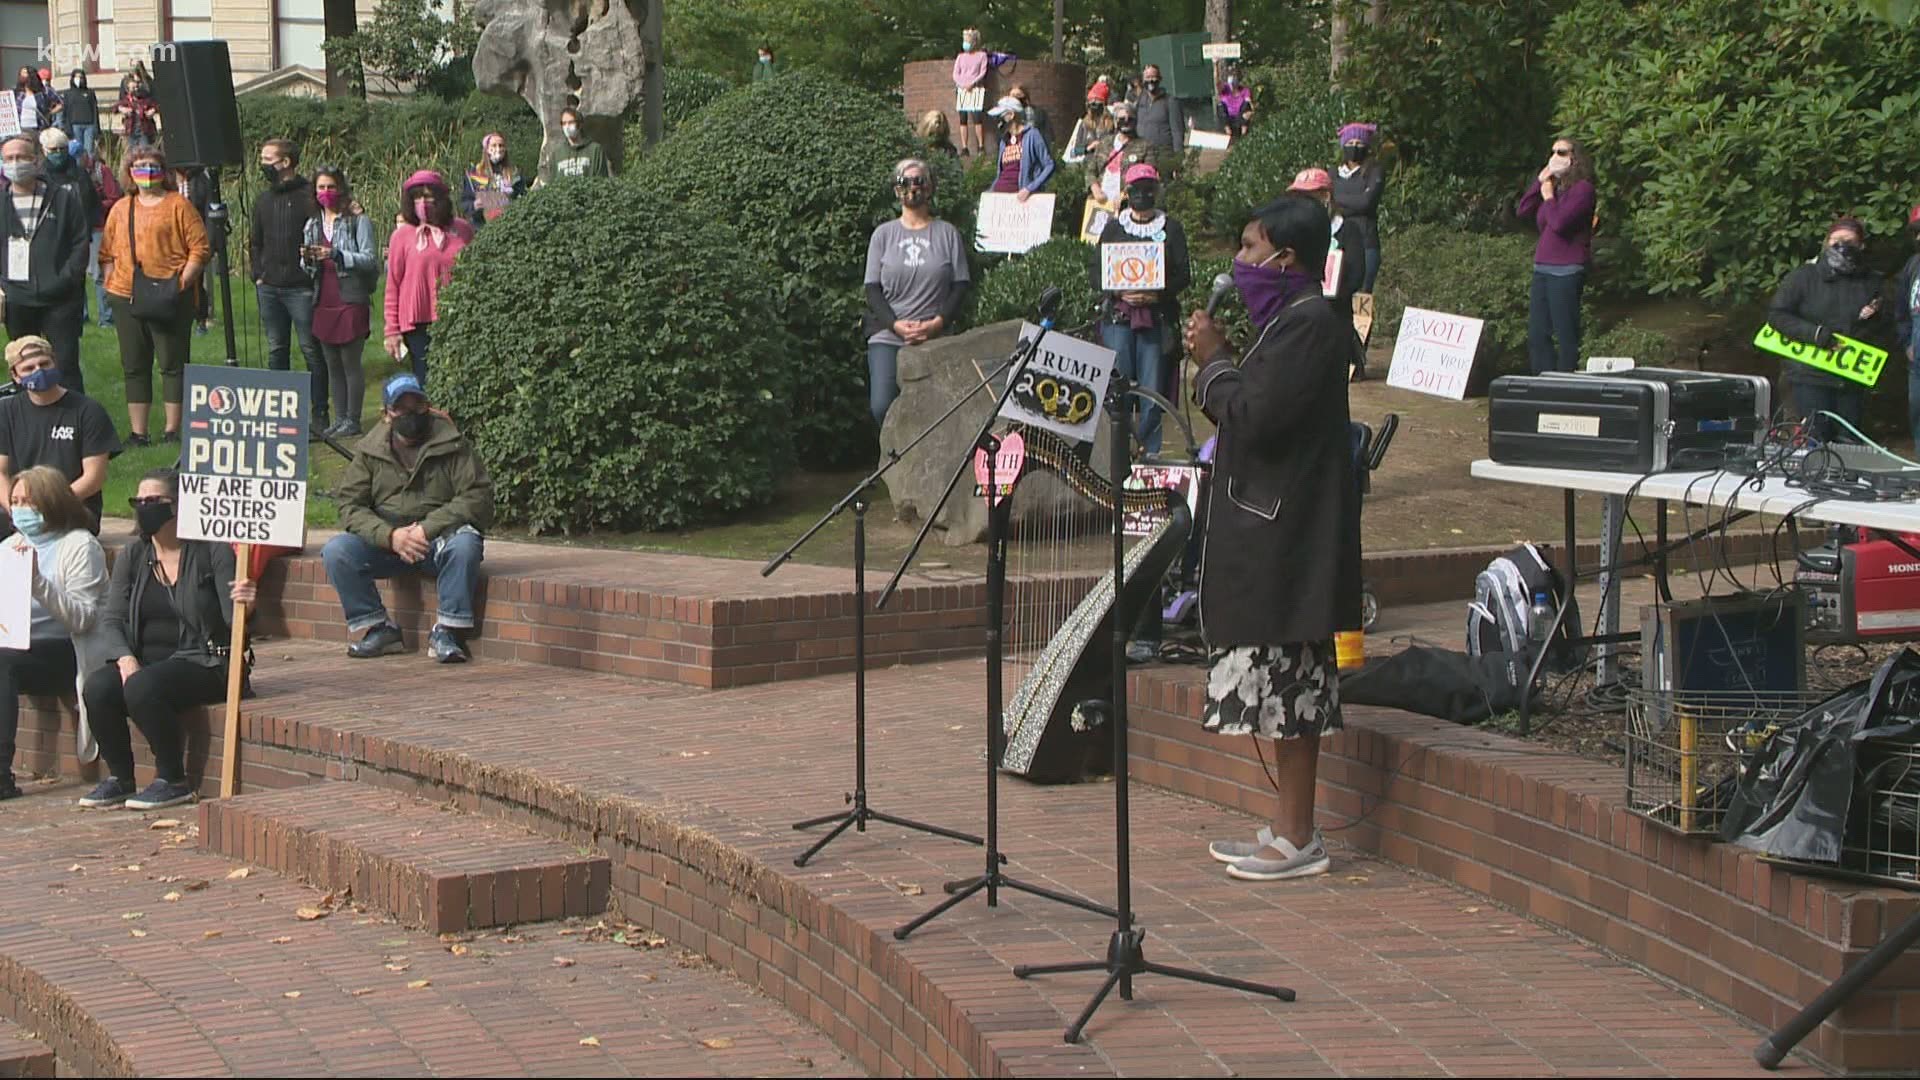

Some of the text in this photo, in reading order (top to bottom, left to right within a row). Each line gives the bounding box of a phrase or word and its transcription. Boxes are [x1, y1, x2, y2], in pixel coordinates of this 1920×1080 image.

[1422, 318, 1470, 343] VOTE
[1031, 346, 1102, 382] TRUMP
[190, 384, 298, 419] POWER
[1015, 373, 1093, 423] 2020
[210, 418, 278, 438] TO THE
[189, 437, 297, 479] POLLS
[181, 475, 299, 501] WE ARE OUR
[200, 497, 277, 520] SISTERS
[200, 517, 270, 540] VOICES
